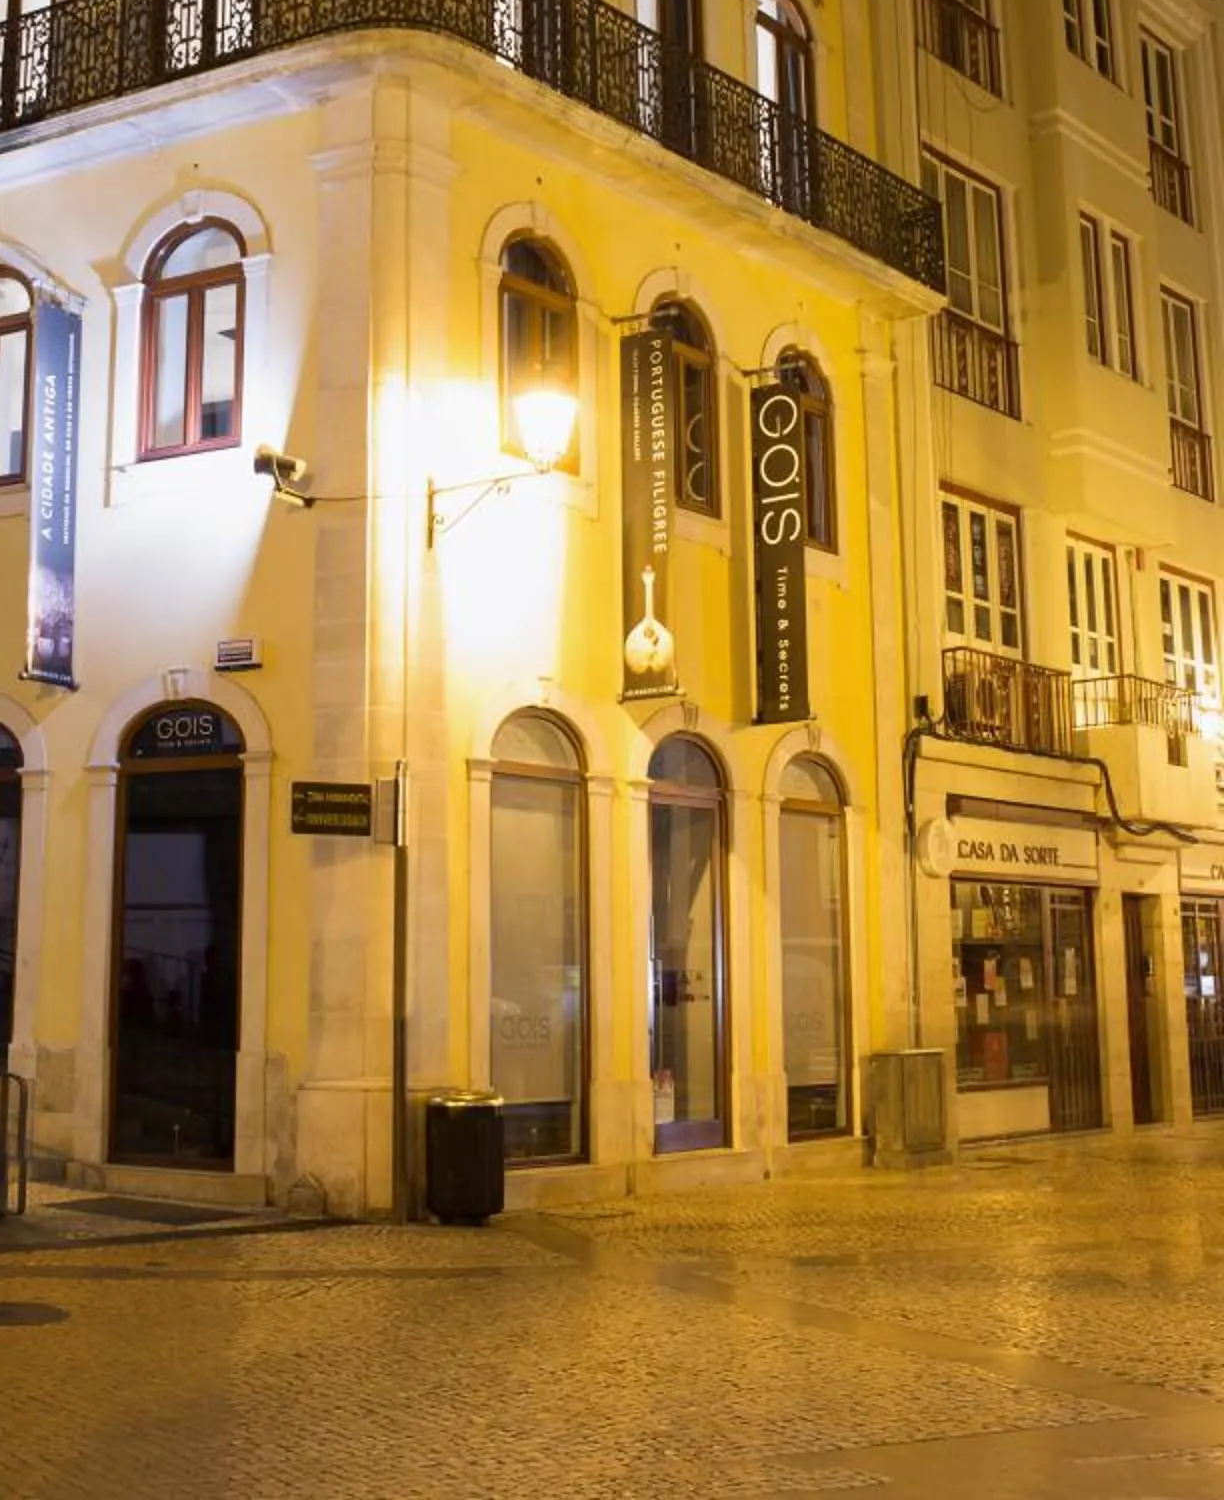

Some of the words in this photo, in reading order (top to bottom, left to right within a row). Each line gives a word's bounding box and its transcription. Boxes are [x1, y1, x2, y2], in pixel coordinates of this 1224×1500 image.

[42, 374, 57, 445] ANTIGA
[648, 339, 666, 461] PORTUGUESE
[40, 452, 56, 520] CIDADE
[652, 469, 668, 554] FILIGREE
[41, 526, 54, 542] A
[777, 566, 788, 609] Time
[777, 619, 789, 631] &
[778, 639, 790, 711] Secrets
[957, 840, 995, 861] CASA
[1000, 843, 1019, 863] DA
[1023, 845, 1059, 867] SORTE
